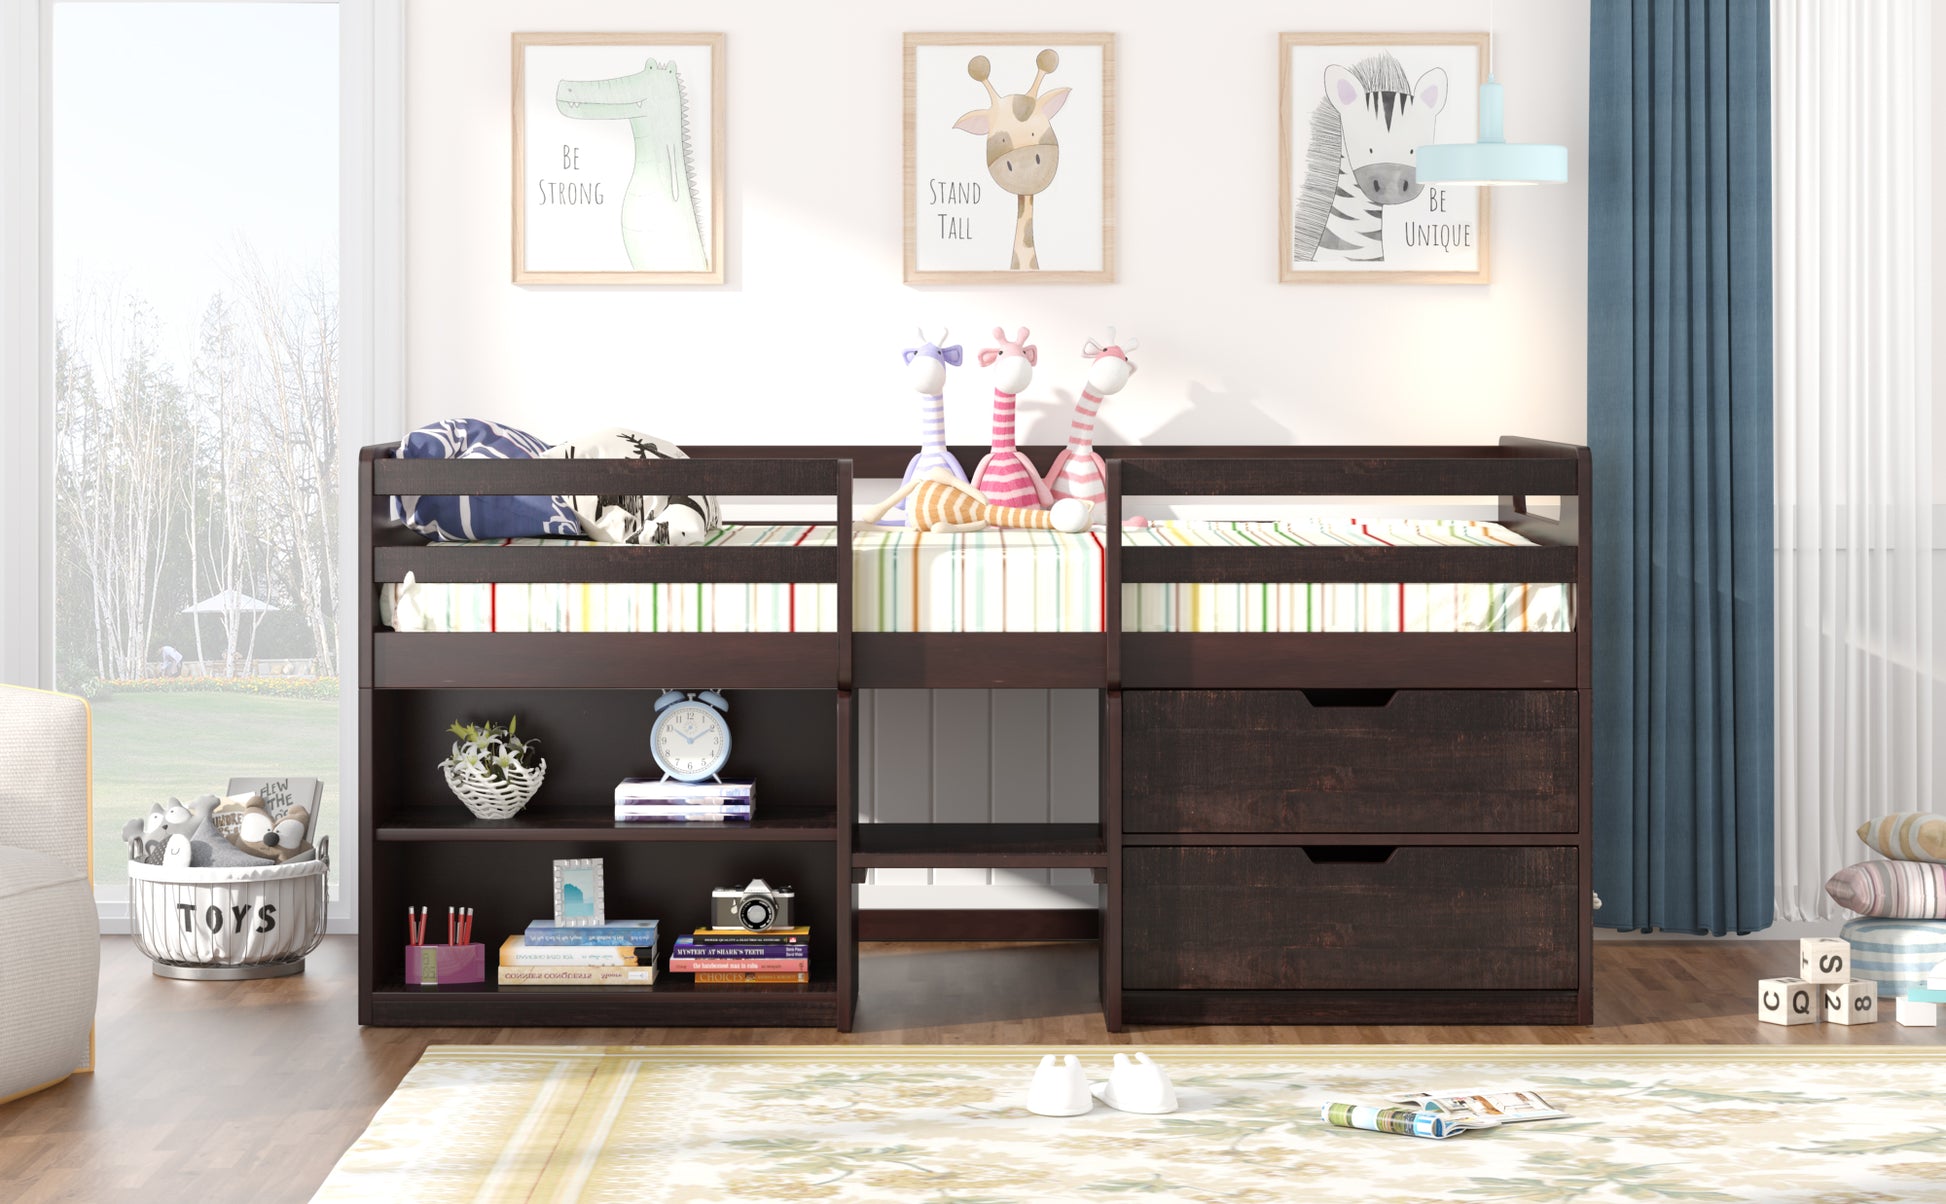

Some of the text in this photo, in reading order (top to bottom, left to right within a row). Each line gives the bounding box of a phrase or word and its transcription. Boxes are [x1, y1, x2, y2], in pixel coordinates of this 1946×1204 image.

[562, 144, 580, 170] BE
[539, 179, 604, 205] STRONG
[929, 178, 981, 205] STAND
[1429, 187, 1446, 212] BE
[937, 213, 973, 240] TALL
[1405, 221, 1470, 253] UNIQUE
[260, 778, 288, 798] FLEW
[267, 793, 293, 810] THE
[177, 903, 276, 934] TOYS
[1819, 954, 1843, 973] S
[700, 973, 743, 981] CHOICES
[1763, 990, 1780, 1011] C
[1792, 990, 1810, 1014] Q
[1825, 993, 1841, 1010] 2
[1854, 995, 1872, 1011] 8
